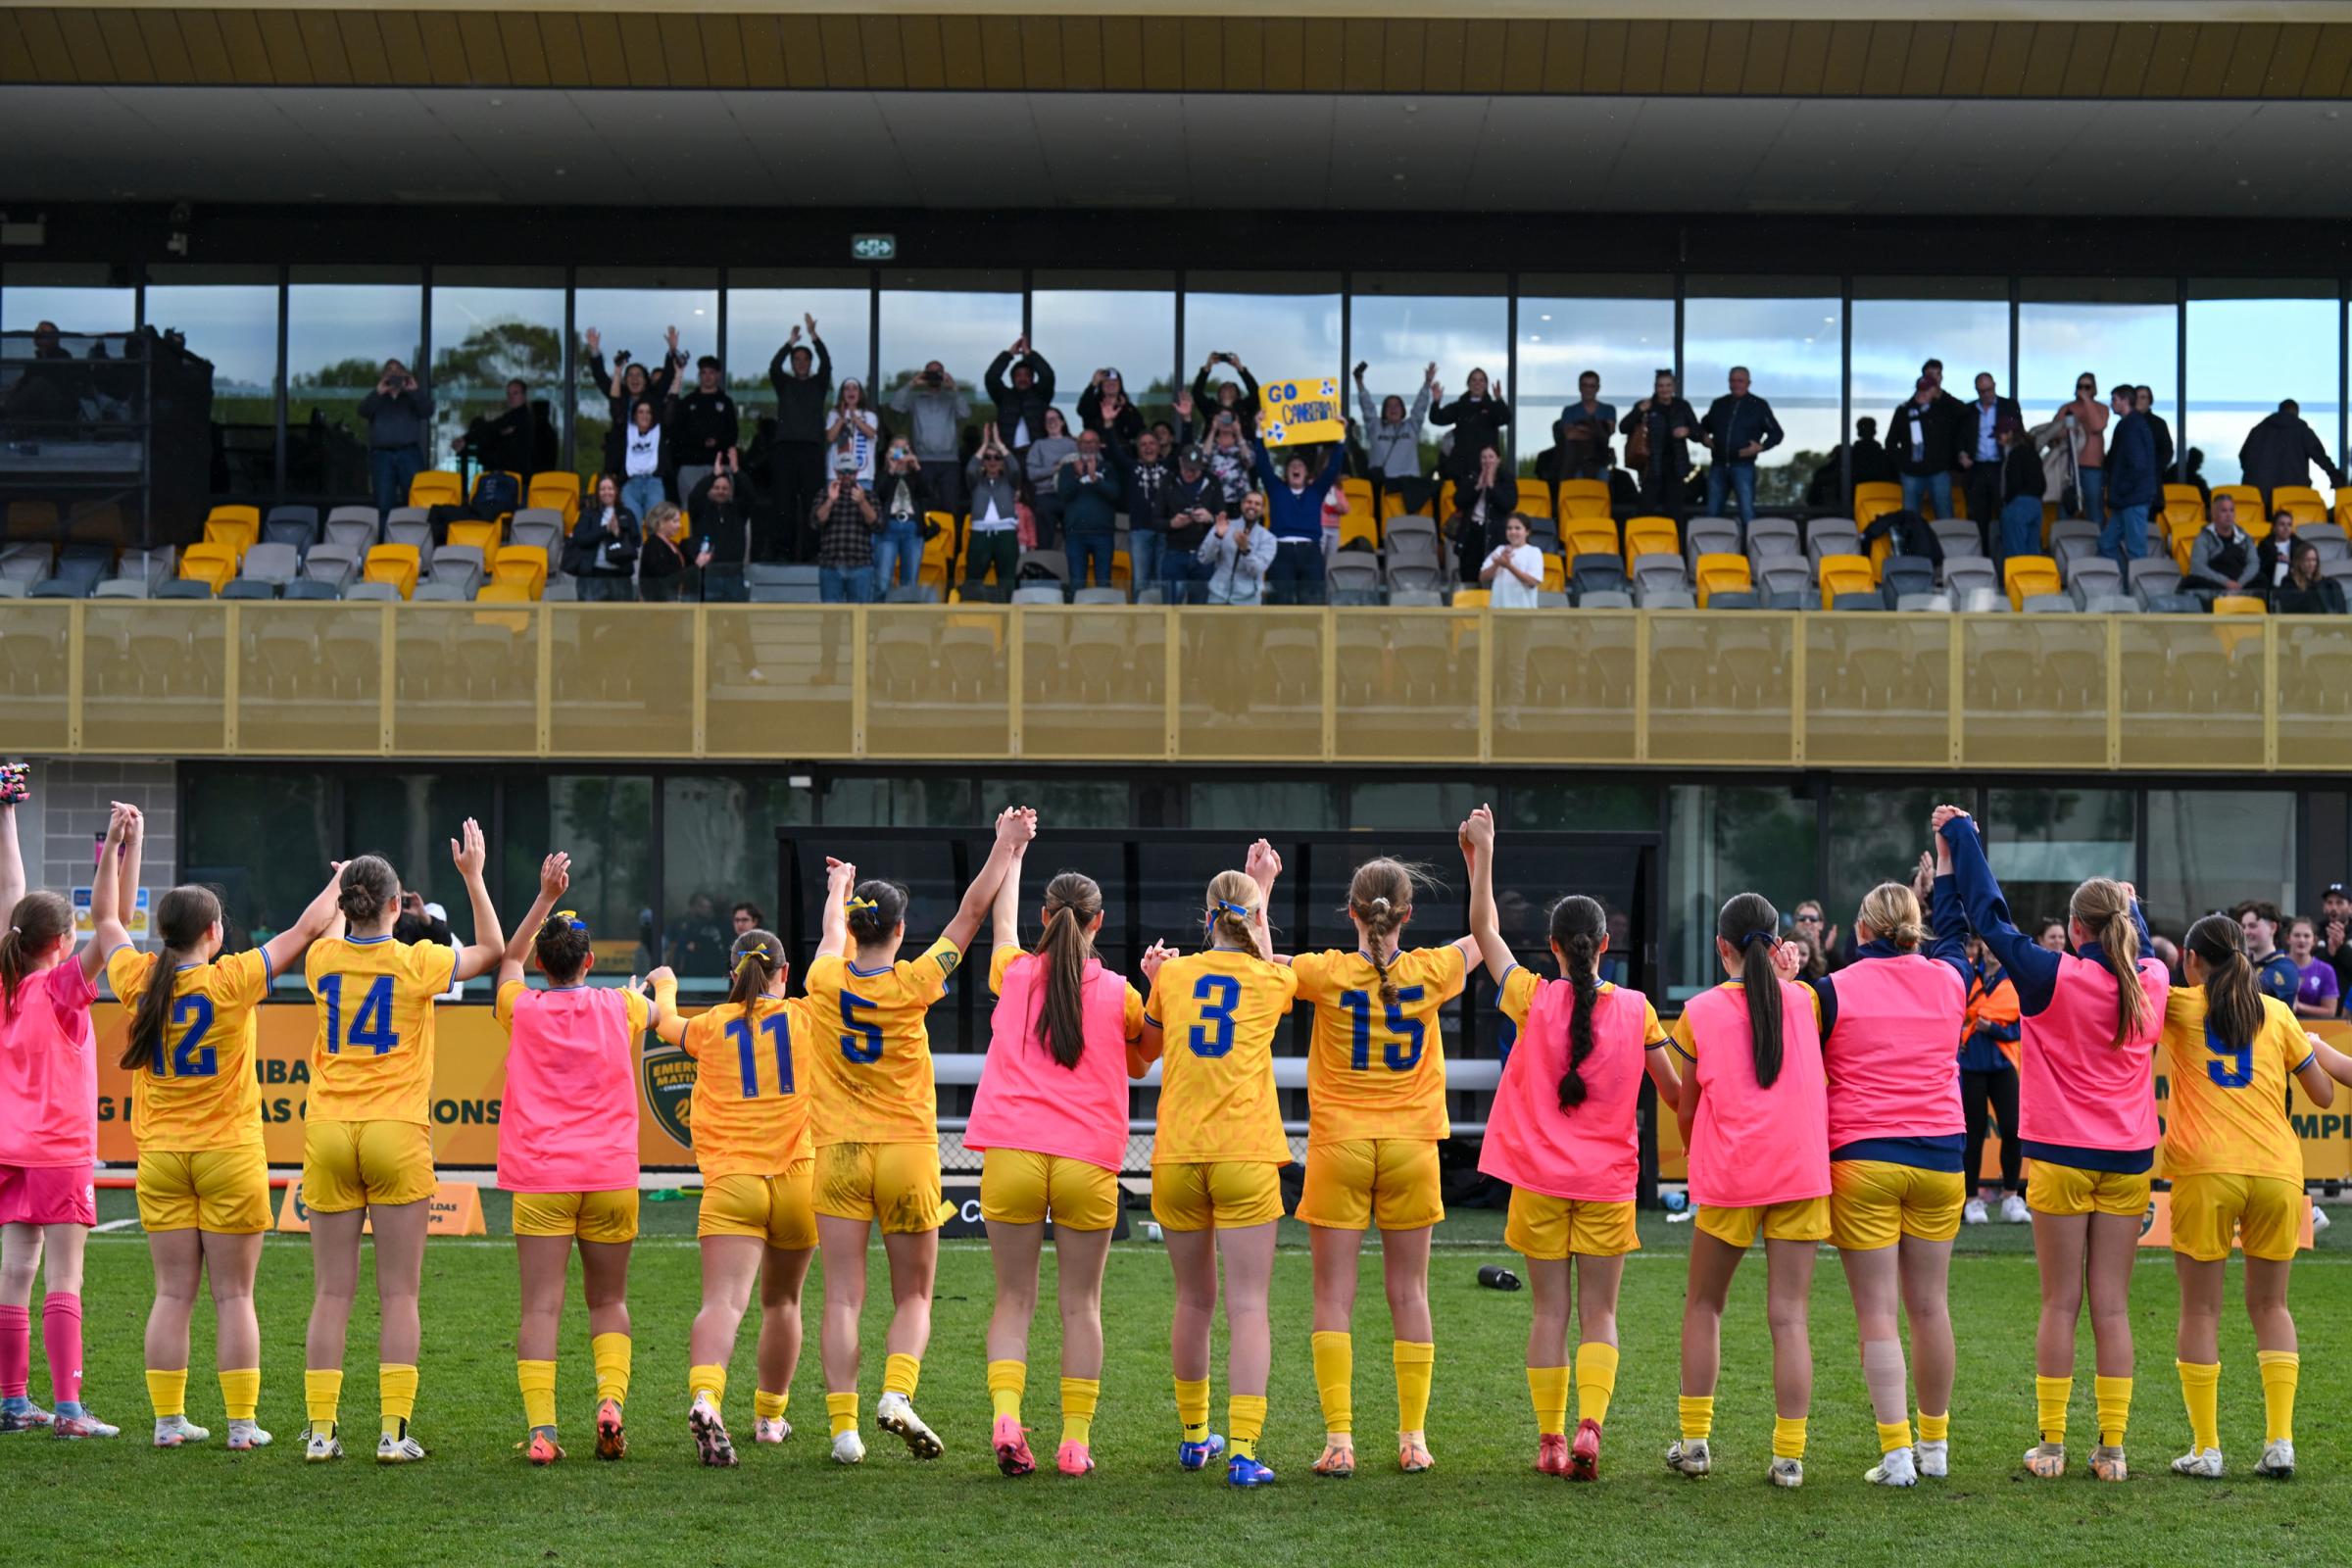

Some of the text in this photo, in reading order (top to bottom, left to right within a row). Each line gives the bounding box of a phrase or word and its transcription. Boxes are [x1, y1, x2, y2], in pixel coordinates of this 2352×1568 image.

[1268, 383, 1298, 403] GO
[317, 972, 400, 1056] 14
[724, 1011, 796, 1099] 11
[840, 988, 884, 1064] 5
[1188, 973, 1242, 1058] 3
[1340, 984, 1427, 1072] 15
[428, 1100, 502, 1125] ONS
